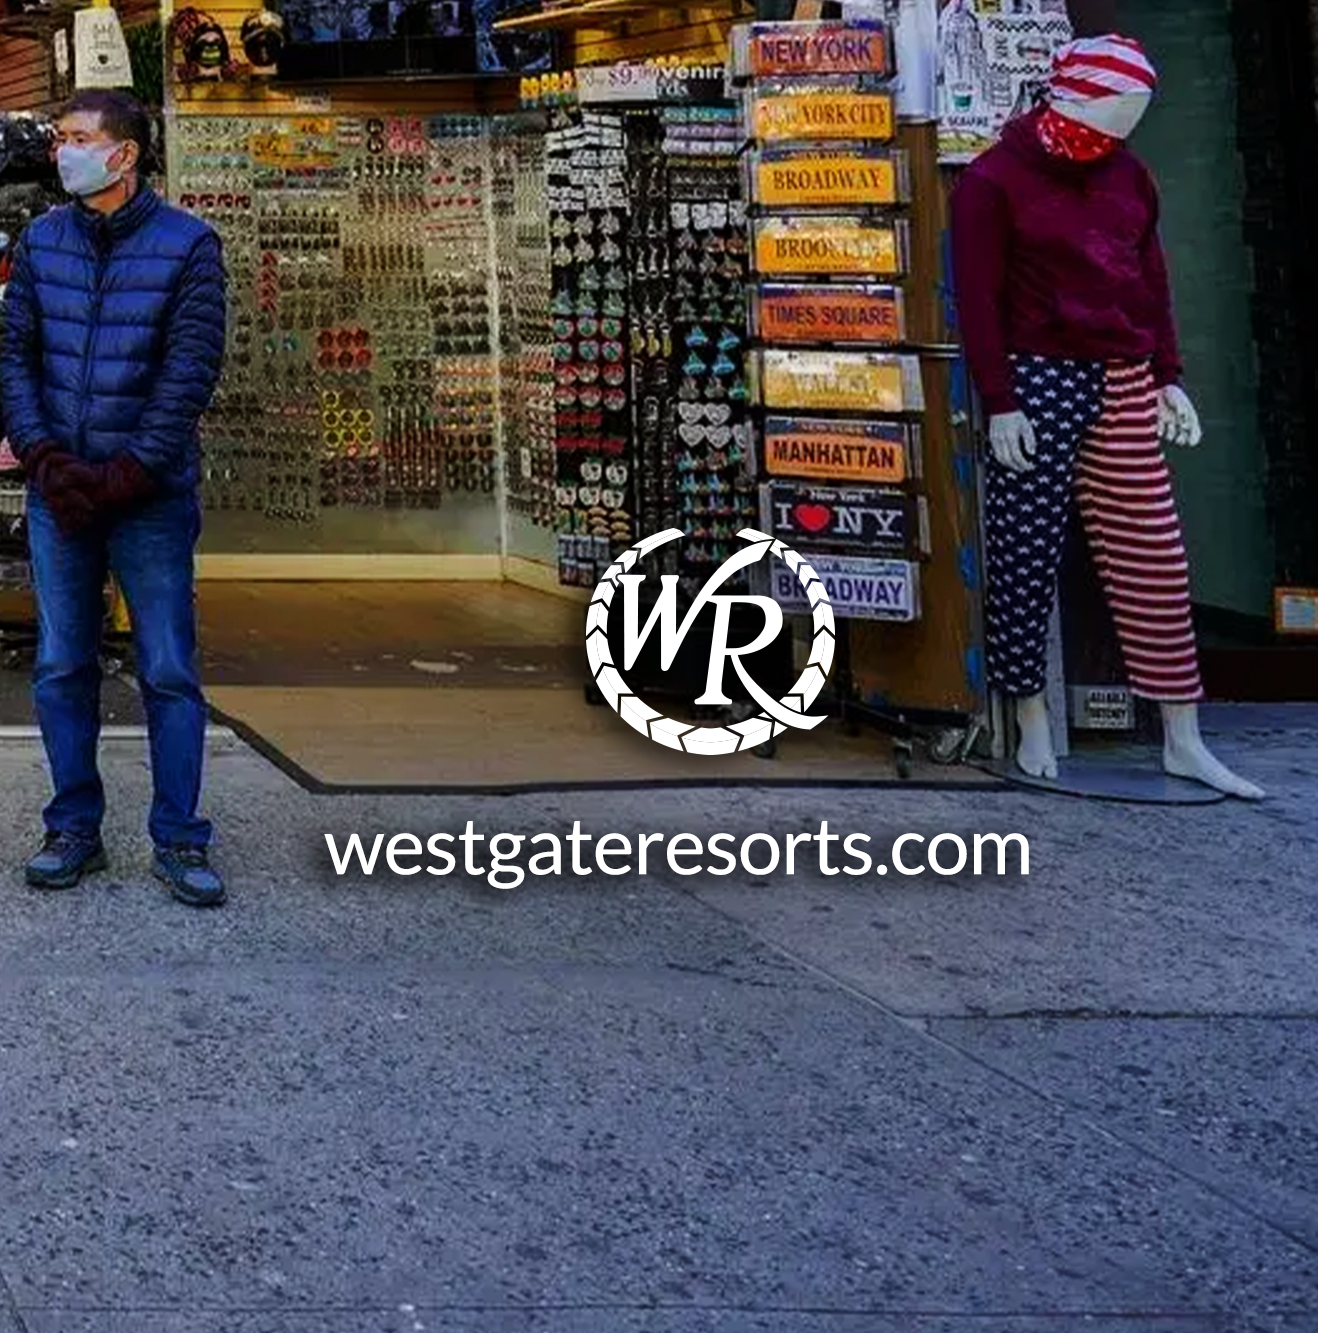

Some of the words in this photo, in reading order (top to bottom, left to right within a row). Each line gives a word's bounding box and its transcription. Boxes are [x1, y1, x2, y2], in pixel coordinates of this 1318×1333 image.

[760, 38, 808, 64] NEW
[812, 35, 872, 63] YORK
[802, 103, 848, 122] YORK
[849, 102, 887, 126] CITY
[773, 167, 882, 191] BROADWAY
[767, 305, 817, 326] TIMES
[821, 305, 892, 327] SQUARE
[773, 440, 895, 469] MANHATTAN
[775, 502, 793, 530] I
[777, 574, 904, 605] BRADWAY
